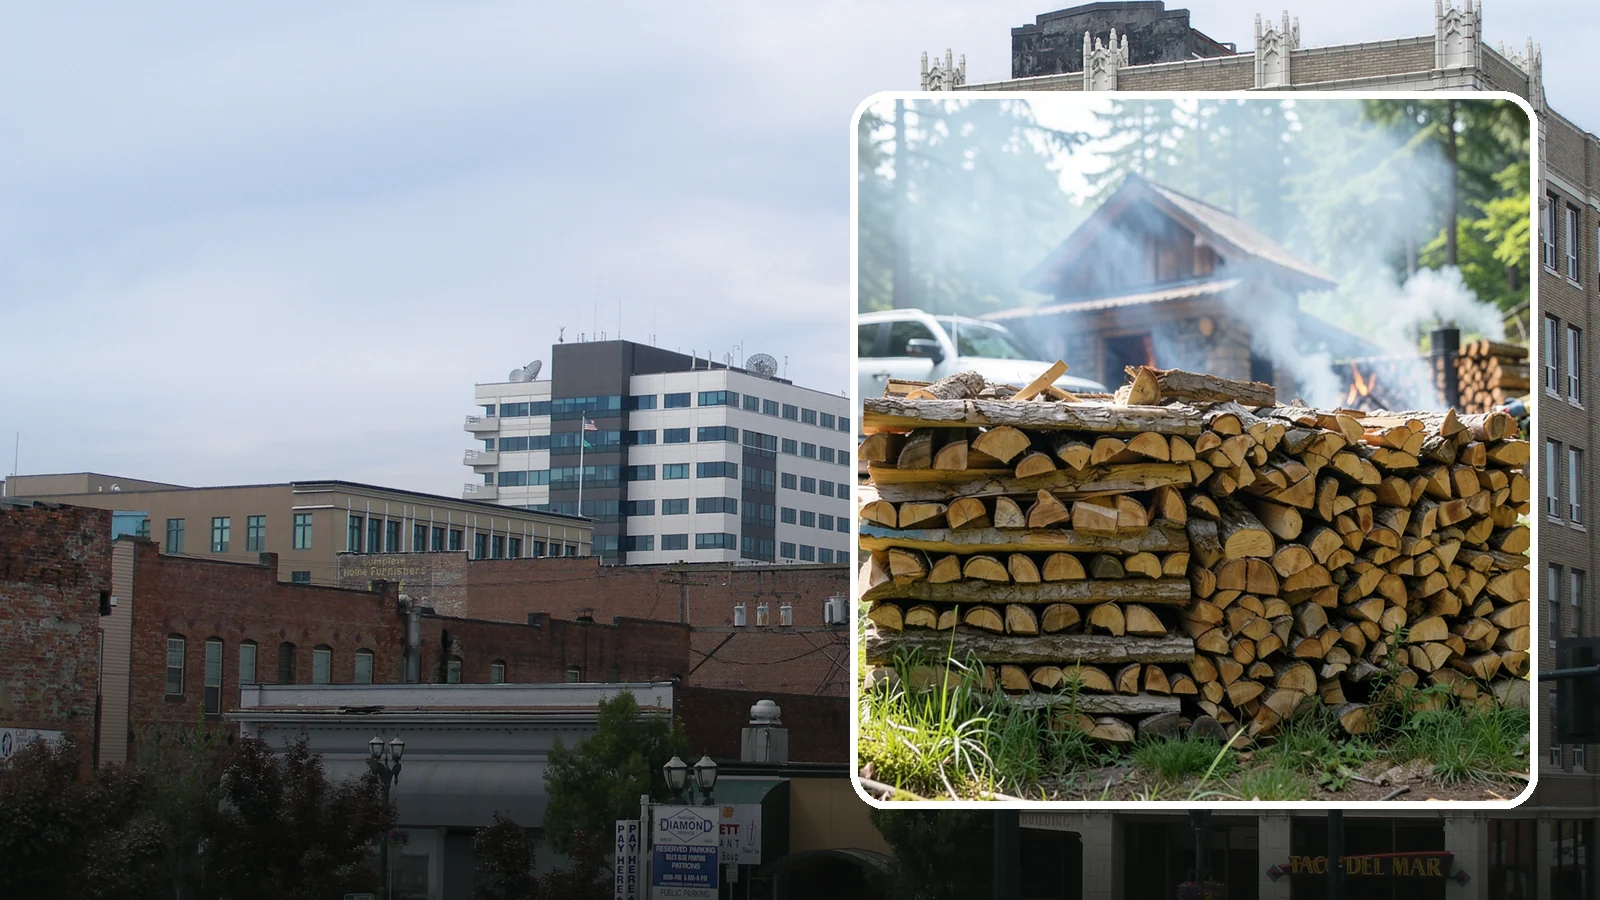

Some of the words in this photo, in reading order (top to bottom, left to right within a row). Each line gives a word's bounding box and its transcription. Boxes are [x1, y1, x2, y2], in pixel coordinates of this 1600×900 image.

[343, 568, 367, 577] Home
[370, 566, 427, 576] Furnishers
[660, 818, 713, 832] DIAMOND
[1022, 815, 1069, 827] BUILDING
[617, 824, 625, 852] PAY
[628, 824, 637, 852] PAY
[655, 845, 688, 853] RESERVED
[689, 846, 716, 854] PARKING
[721, 851, 739, 862] Soup
[671, 862, 701, 870] PATRONS
[1290, 855, 1331, 874] TAC
[1346, 856, 1385, 875] DEL
[1392, 857, 1443, 877] MAR
[616, 856, 625, 893] HERE
[627, 856, 637, 893] HERE
[660, 889, 682, 897] PUBLIC
[683, 889, 710, 898] PARKING
